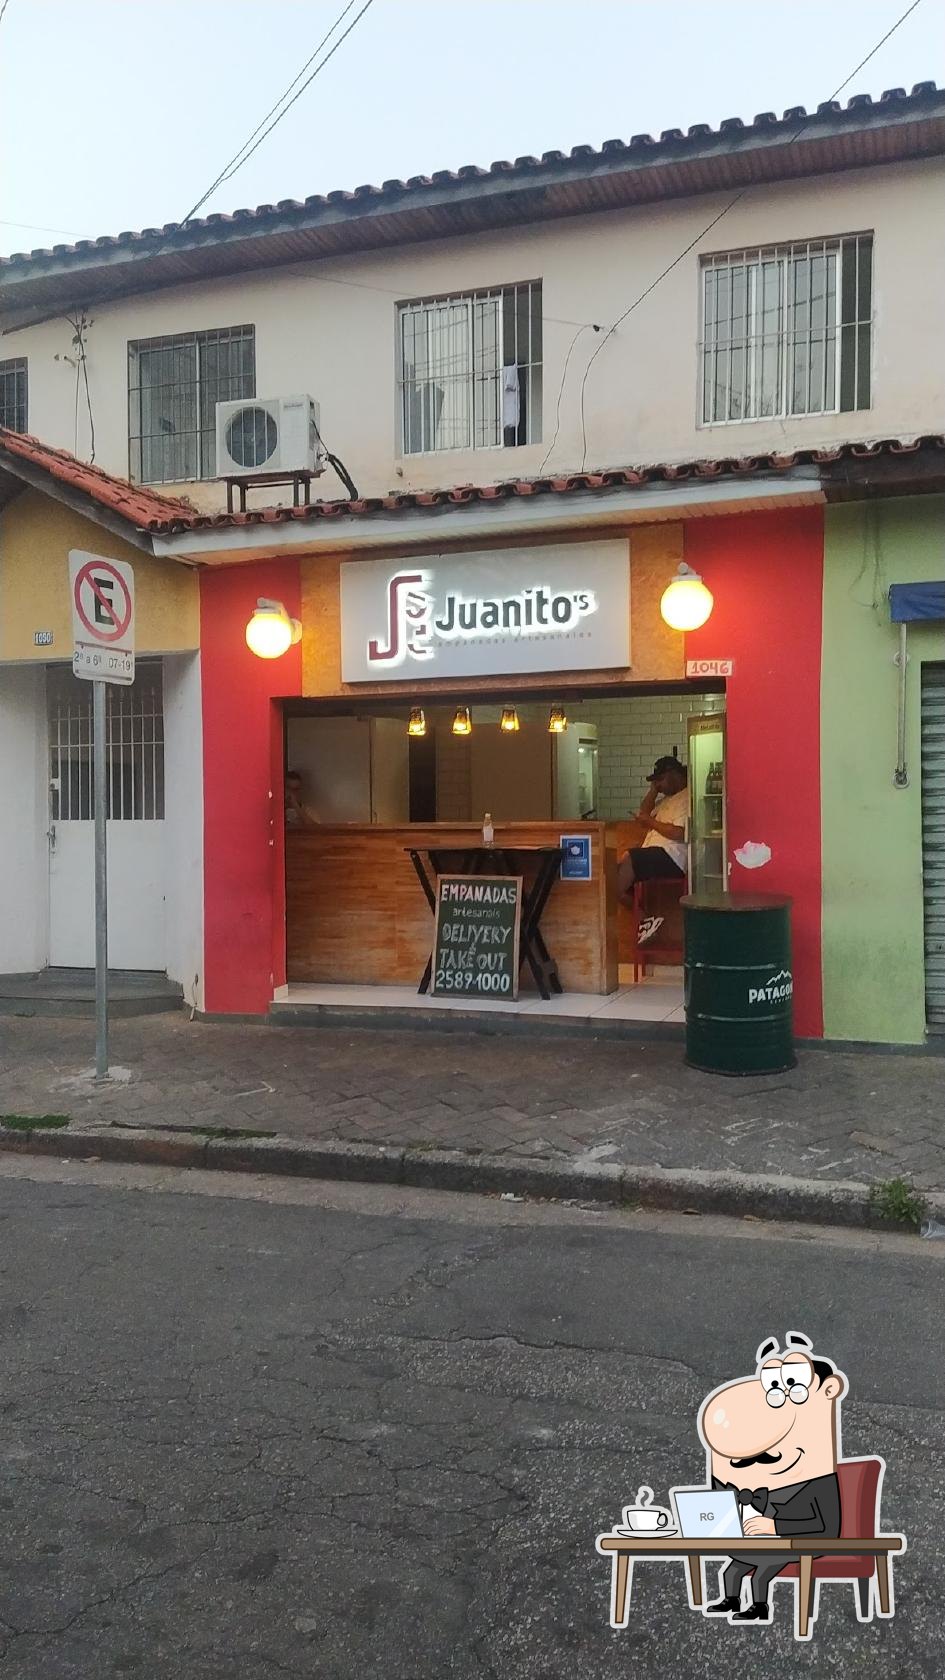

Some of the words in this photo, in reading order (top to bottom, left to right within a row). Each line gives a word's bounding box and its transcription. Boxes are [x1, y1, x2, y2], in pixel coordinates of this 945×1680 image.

[436, 588, 589, 631] Juanito's
[691, 661, 729, 674] 1046
[441, 884, 516, 904] EMPANADAS
[442, 923, 512, 944] DELIVERY
[440, 949, 474, 969] TAKE
[477, 953, 507, 971] OUT
